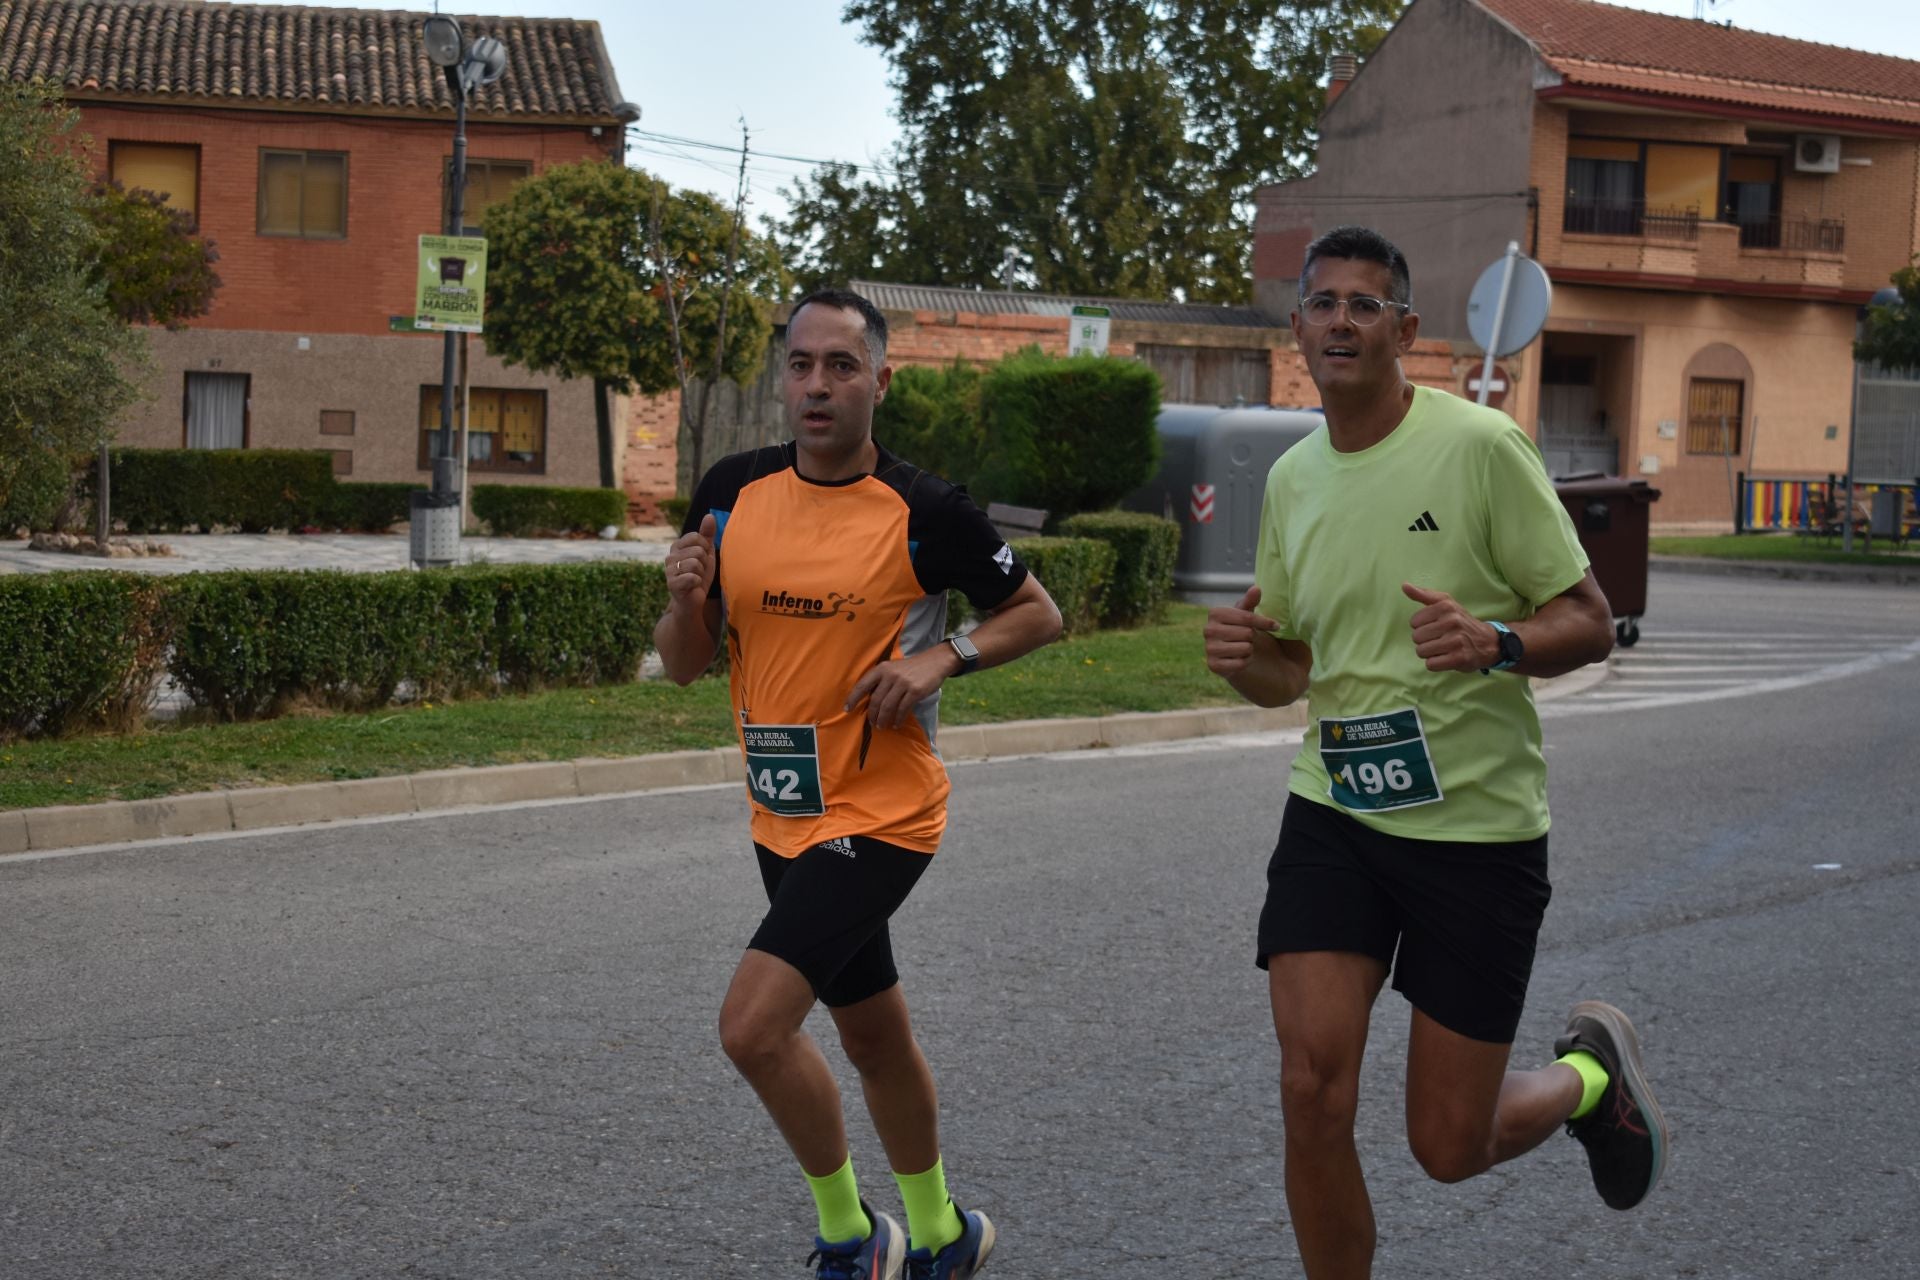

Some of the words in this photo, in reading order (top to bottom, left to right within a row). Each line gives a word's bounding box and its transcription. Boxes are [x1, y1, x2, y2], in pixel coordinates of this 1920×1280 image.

[762, 590, 824, 611] Inferno
[1345, 724, 1363, 733] CAJA
[1364, 721, 1390, 731] RURAL
[745, 732, 763, 740] CAJA
[763, 732, 790, 740] RURAL
[1347, 733, 1357, 741] DE
[1358, 728, 1396, 740] NAVARRA
[757, 739, 795, 747] NAVARRA
[1340, 759, 1413, 794] 196
[818, 842, 857, 858] adidas
